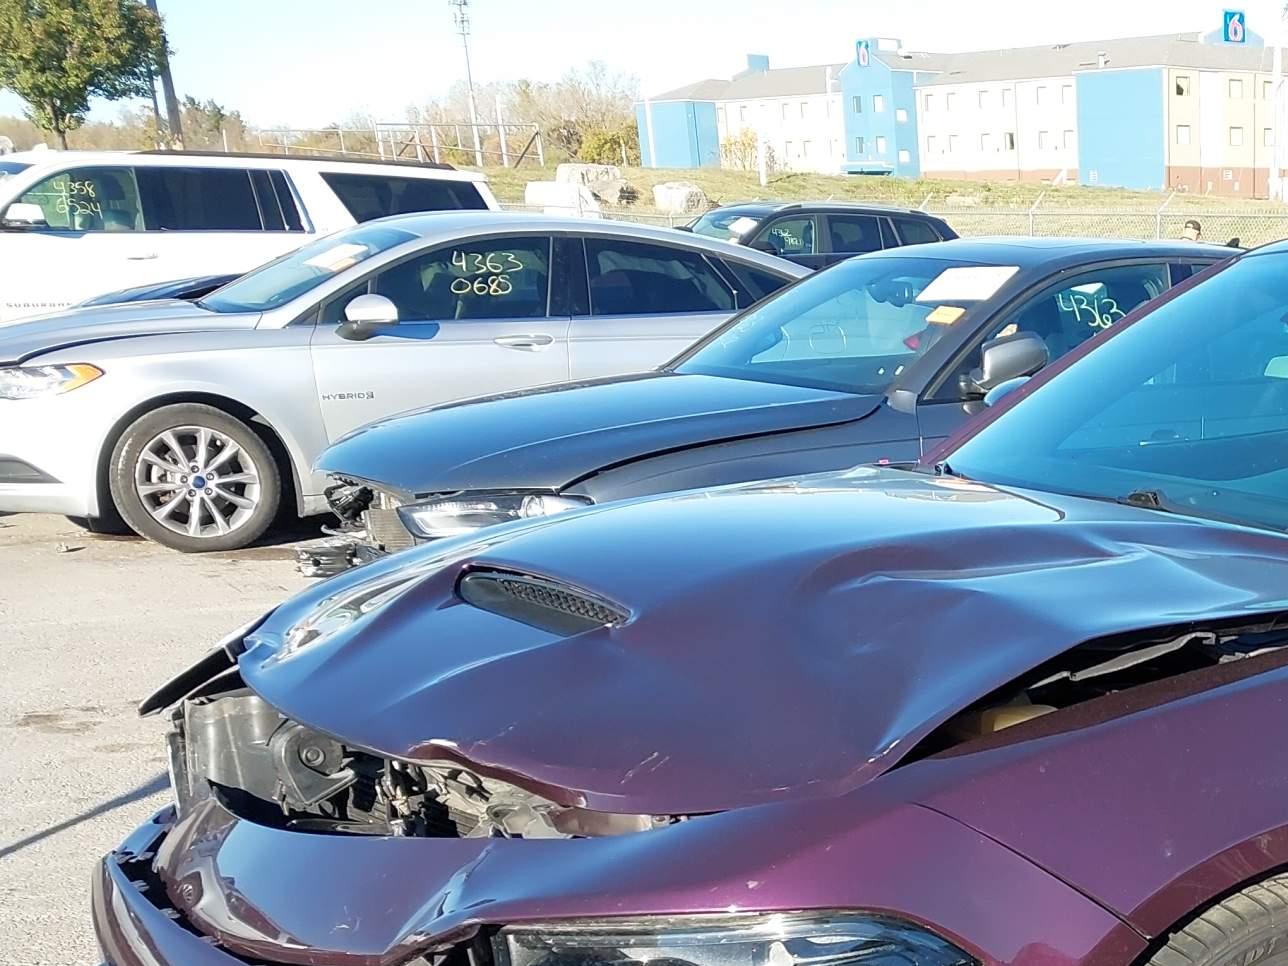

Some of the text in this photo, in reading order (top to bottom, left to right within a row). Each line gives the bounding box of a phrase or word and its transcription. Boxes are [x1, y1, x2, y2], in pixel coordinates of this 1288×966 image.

[1228, 13, 1243, 41] 6
[53, 181, 96, 198] 4358
[452, 251, 524, 274] 4363
[450, 275, 513, 295] 0685
[1058, 293, 1127, 329] 4363
[322, 392, 366, 401] HYBRID
